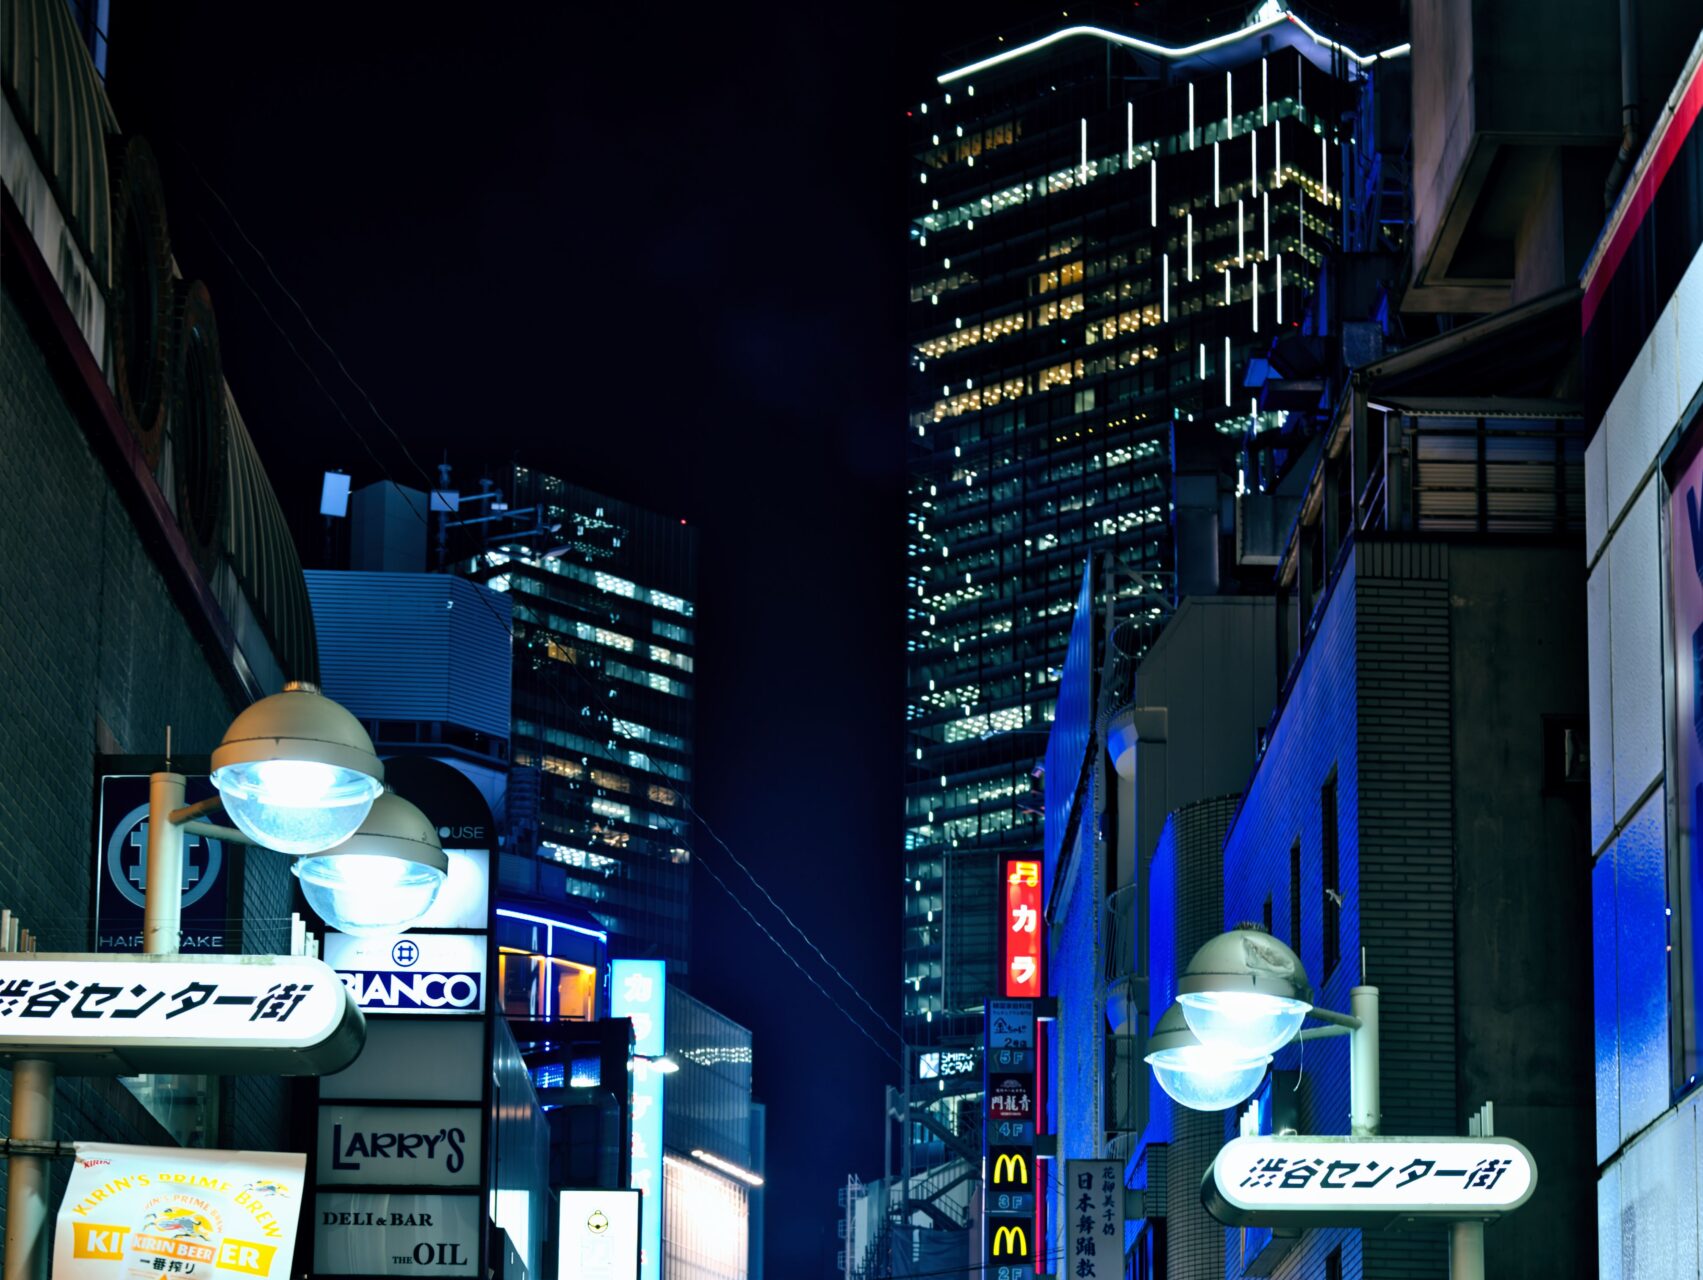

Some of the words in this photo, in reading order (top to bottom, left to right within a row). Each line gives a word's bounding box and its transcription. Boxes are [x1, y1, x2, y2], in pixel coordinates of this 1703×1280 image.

[1011, 904, 1037, 984] カラ
[333, 1124, 466, 1173] LARRY'S
[1240, 1158, 1512, 1190] 渋谷センター街
[73, 1174, 150, 1216] KIRIN'S
[233, 1190, 283, 1239] BREW
[323, 1212, 374, 1226] DELI
[390, 1213, 433, 1226] BAR
[140, 1257, 195, 1275] 一番搾り
[413, 1243, 468, 1265] OIL
